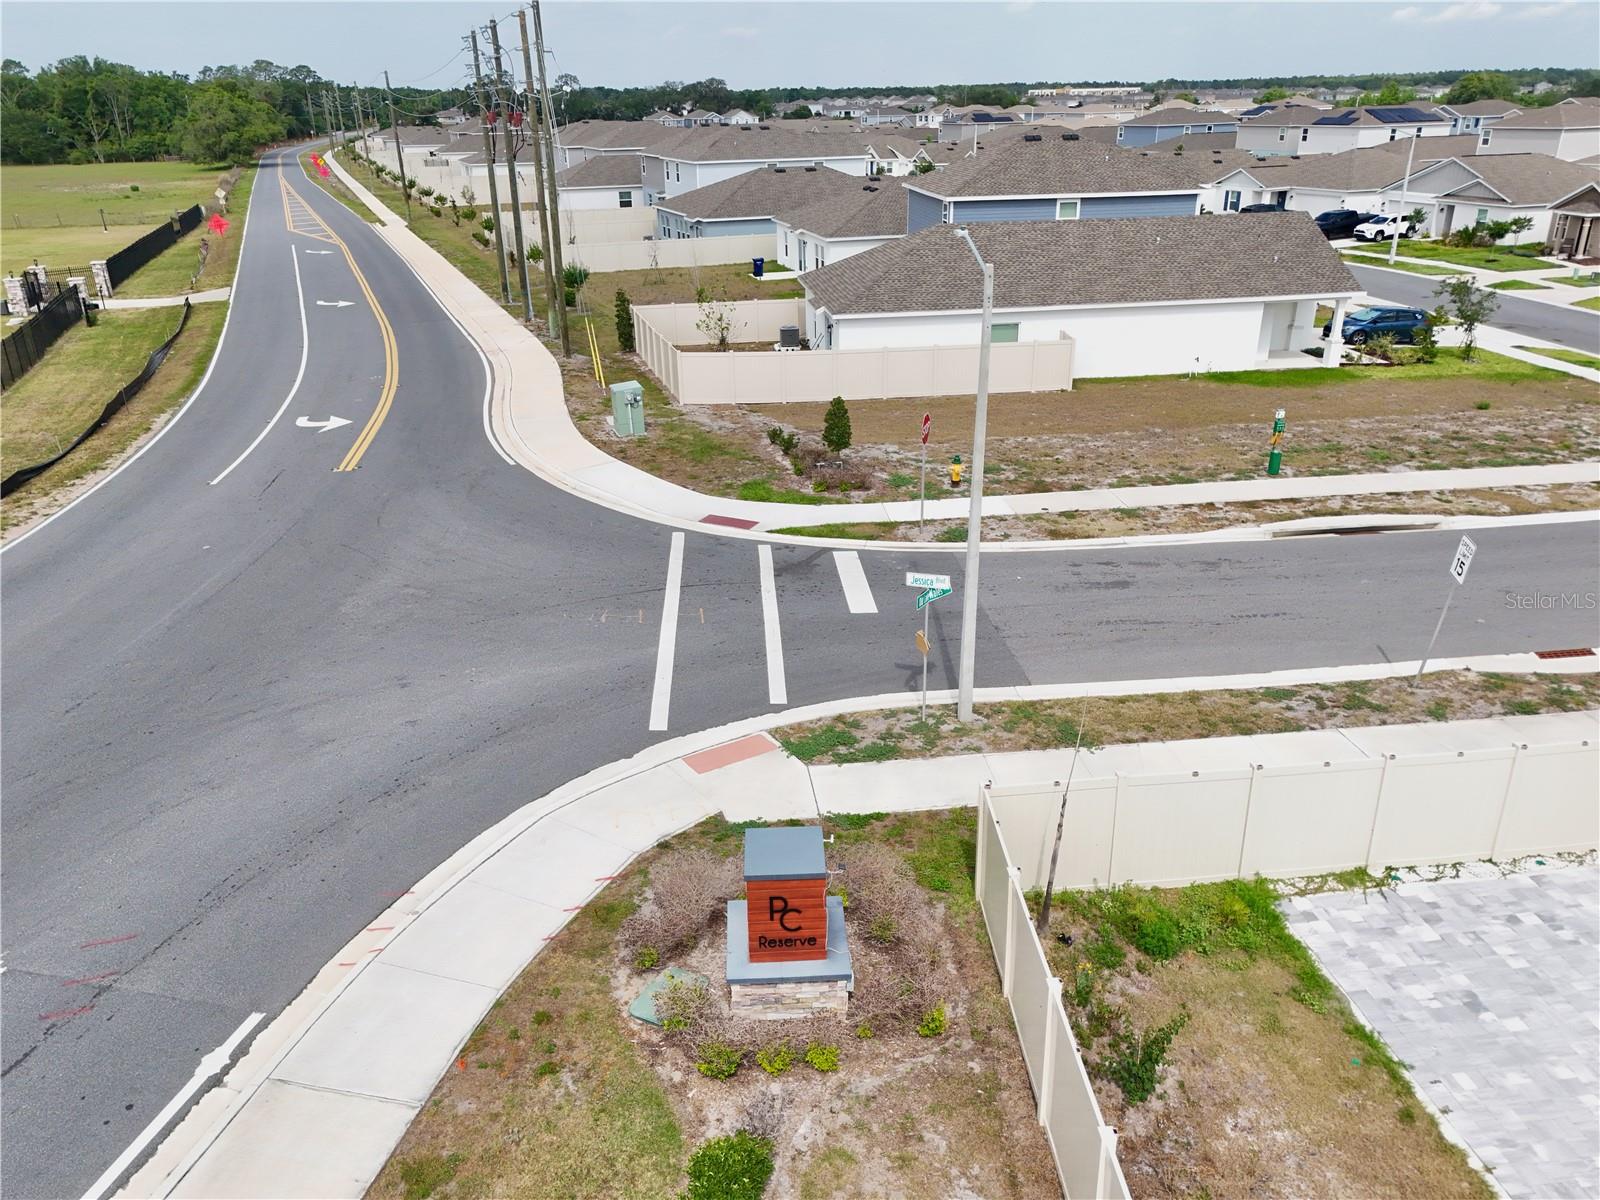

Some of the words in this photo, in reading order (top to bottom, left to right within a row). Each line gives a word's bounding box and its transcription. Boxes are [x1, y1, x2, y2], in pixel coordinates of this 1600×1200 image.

[1454, 557, 1466, 577] 15
[911, 575, 934, 587] Jessica
[768, 896, 803, 932] PC
[758, 935, 818, 949] Reserve
